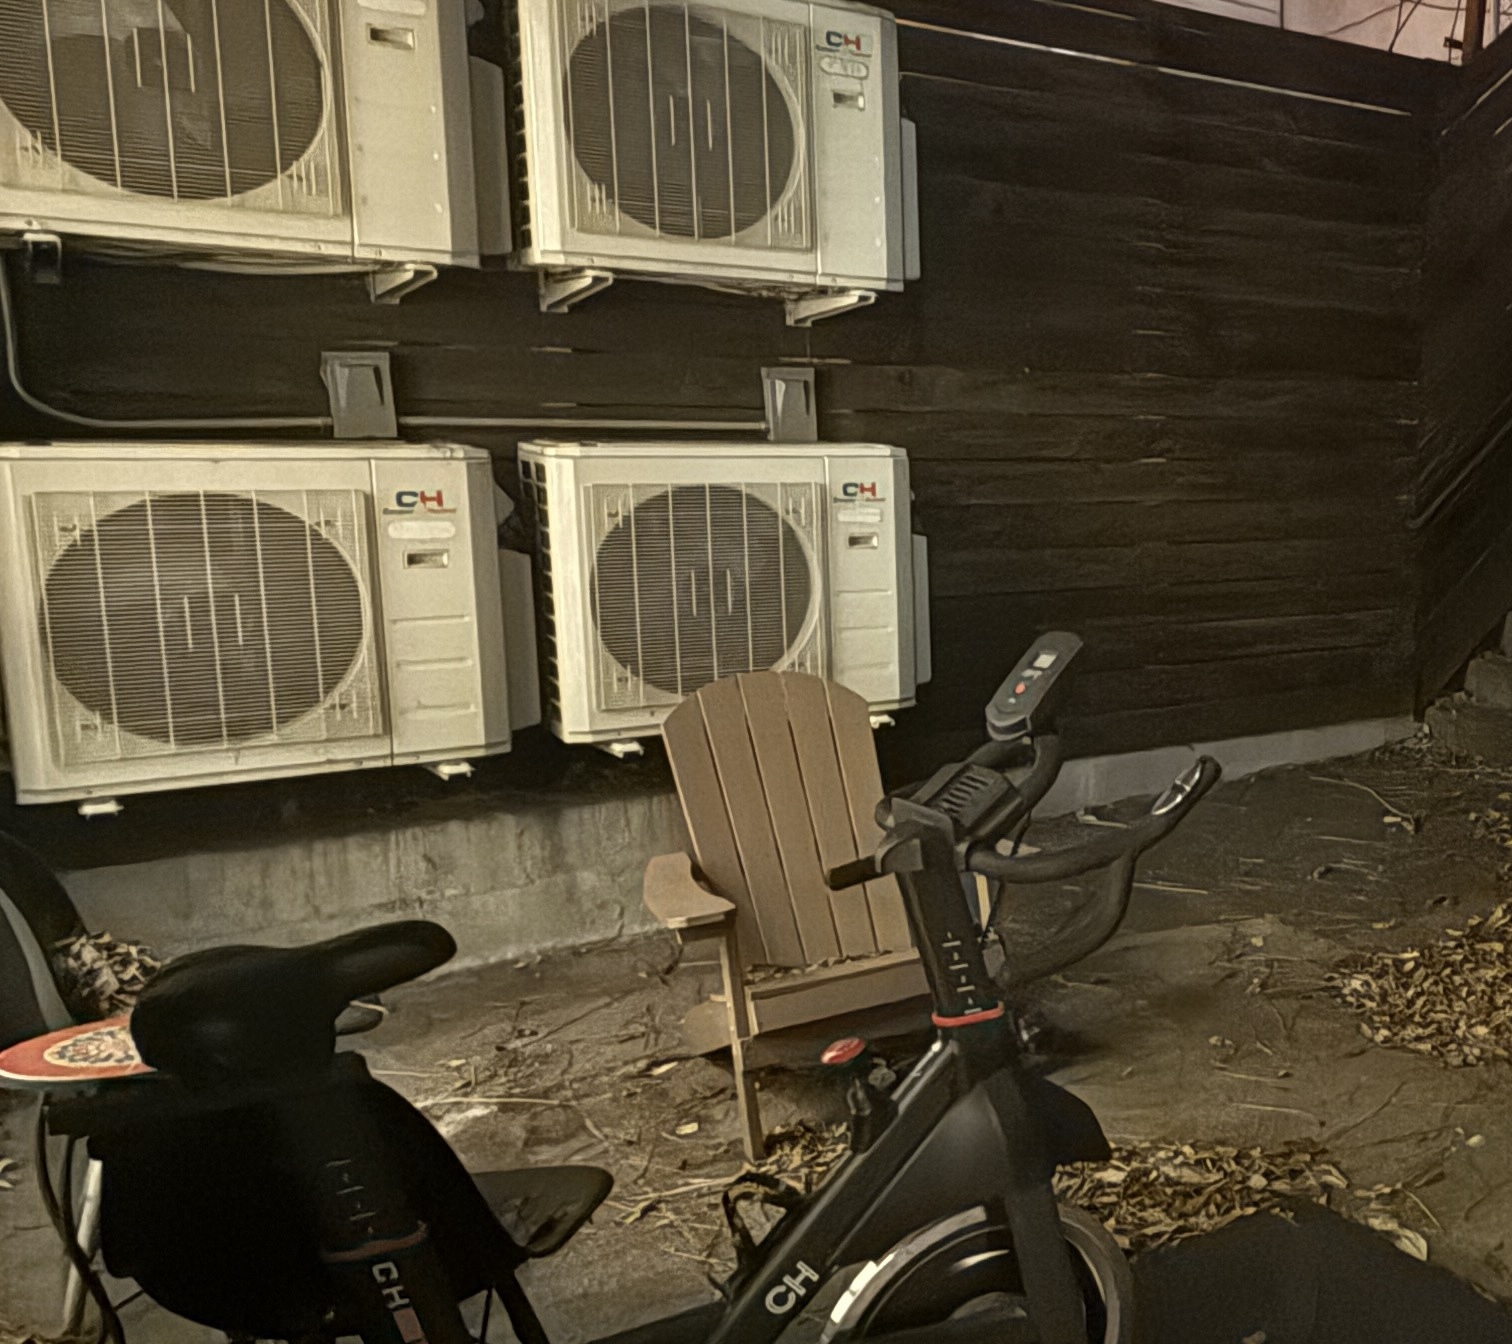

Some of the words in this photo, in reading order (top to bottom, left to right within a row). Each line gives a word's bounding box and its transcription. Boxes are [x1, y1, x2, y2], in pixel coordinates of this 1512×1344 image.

[825, 30, 861, 52] CH
[395, 489, 443, 508] CH
[841, 482, 877, 497] CH
[371, 1261, 410, 1309] CH
[765, 1260, 820, 1315] CH
